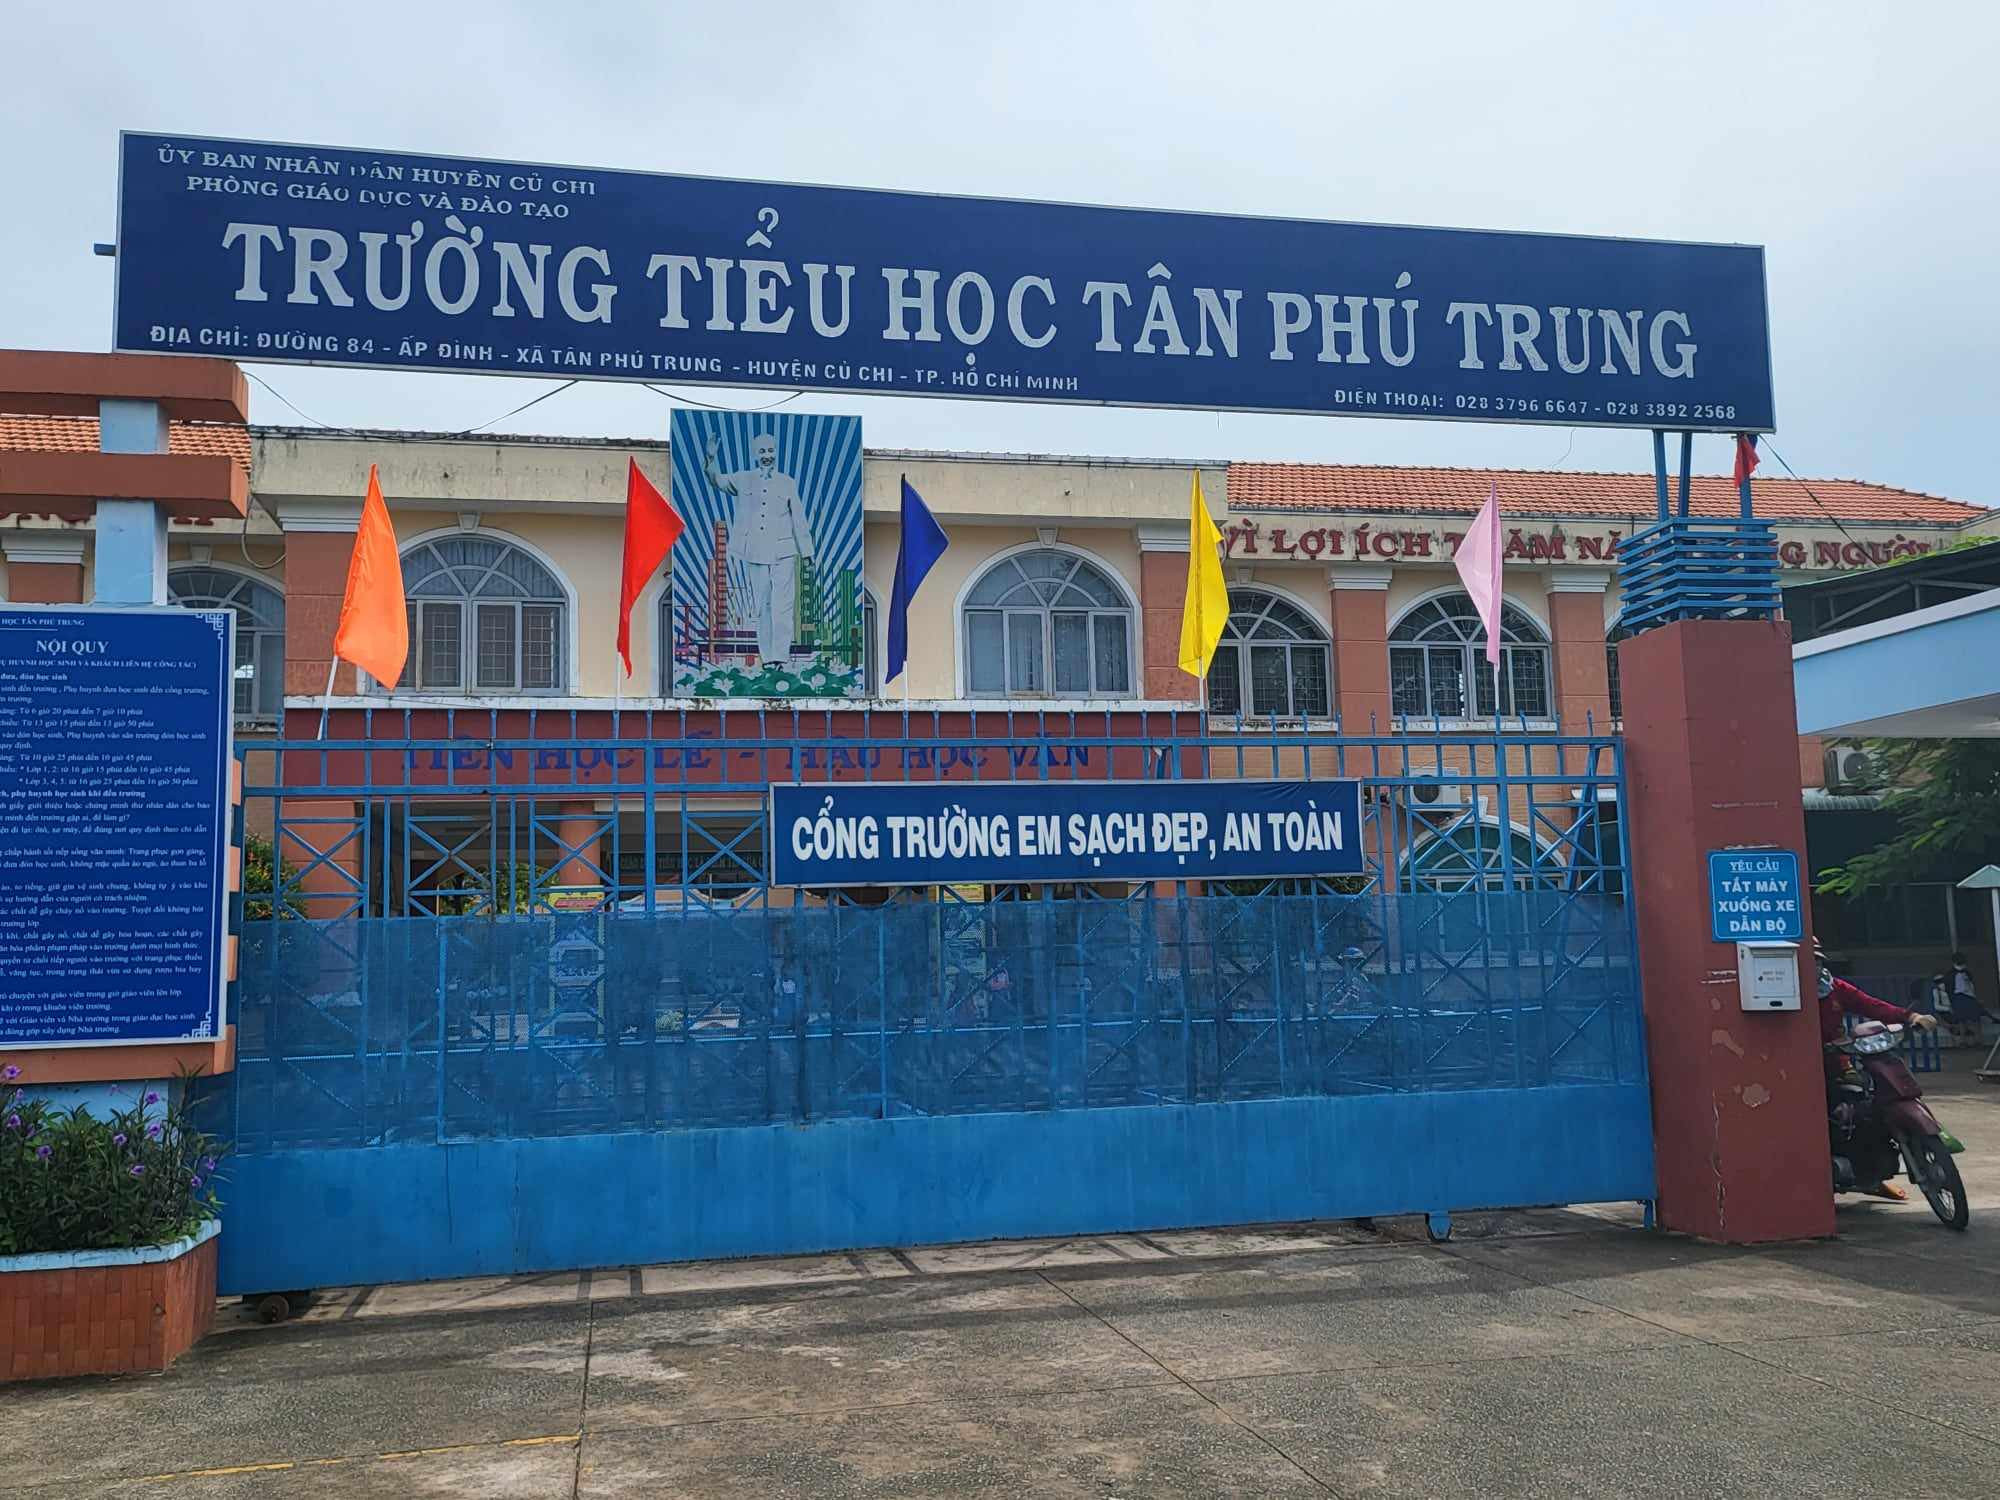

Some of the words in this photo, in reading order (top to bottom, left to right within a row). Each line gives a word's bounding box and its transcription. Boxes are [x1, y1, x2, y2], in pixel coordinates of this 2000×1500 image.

[158, 144, 194, 163] ỦY
[203, 152, 256, 168] BAN
[265, 156, 340, 174] NHÂN
[510, 173, 542, 191] CỦ
[552, 180, 594, 194] CHI
[187, 176, 278, 196] PHÒNG
[288, 182, 348, 201] GIÁO
[360, 190, 411, 207] DỤC
[419, 192, 453, 209] VÀ
[461, 196, 512, 214] ĐÀO
[520, 202, 568, 219] TẠO
[222, 214, 618, 324] TRƯỜNG
[646, 208, 855, 337] TIỂU
[882, 268, 1056, 365] HỌC
[1082, 262, 1242, 357] TÂN
[1268, 272, 1418, 366] PHÚ
[1446, 302, 1697, 378] TRUNG
[150, 326, 190, 346] ĐỊA
[200, 326, 248, 346] CHỈ:
[257, 331, 338, 351] ĐƯỜNG
[347, 338, 373, 353] 84
[399, 336, 427, 356] ẤP
[438, 340, 492, 360] ĐÌNH
[517, 346, 543, 363] XÃ
[552, 347, 591, 366] TÂN
[601, 350, 642, 368] PHÚ
[651, 355, 721, 372] TRUNG
[749, 359, 815, 380] HUYỆN
[825, 361, 850, 379] CỦ
[859, 367, 892, 382] CHI
[915, 370, 944, 384] TP.
[953, 367, 978, 386] HỒ
[986, 371, 1018, 388] CHÍ
[1028, 376, 1077, 390] MINH
[1335, 388, 1376, 407] ĐIỆN
[1384, 392, 1443, 410] THOẠI:
[1456, 396, 1488, 408] 028
[1496, 398, 1538, 411] 3796
[1546, 400, 1587, 413] 6647
[1607, 402, 1638, 415] 028
[1646, 404, 1687, 416] 3892
[1694, 405, 1735, 419] 2568
[1272, 525, 1345, 560] LỢI
[1355, 522, 1433, 557] ÍCH
[37, 638, 66, 655] NỘI
[72, 641, 108, 655] QUY
[792, 796, 879, 860] CỔNG
[887, 805, 1010, 858] TRƯỜNG
[1018, 816, 1061, 855] EM
[1068, 813, 1145, 866] SẠCH
[1152, 813, 1215, 864] ĐẸP,
[1224, 813, 1261, 850] AN
[1268, 800, 1342, 851] TOÀN
[1730, 861, 1752, 871] YÊU
[1756, 858, 1780, 871] CẦU
[1722, 877, 1751, 893] TẮT
[1756, 878, 1788, 892] MÁY
[1718, 896, 1772, 913] XUỐNG
[1776, 900, 1796, 912] XE
[1730, 914, 1761, 932] DẪN
[1766, 917, 1786, 934] BỘ
